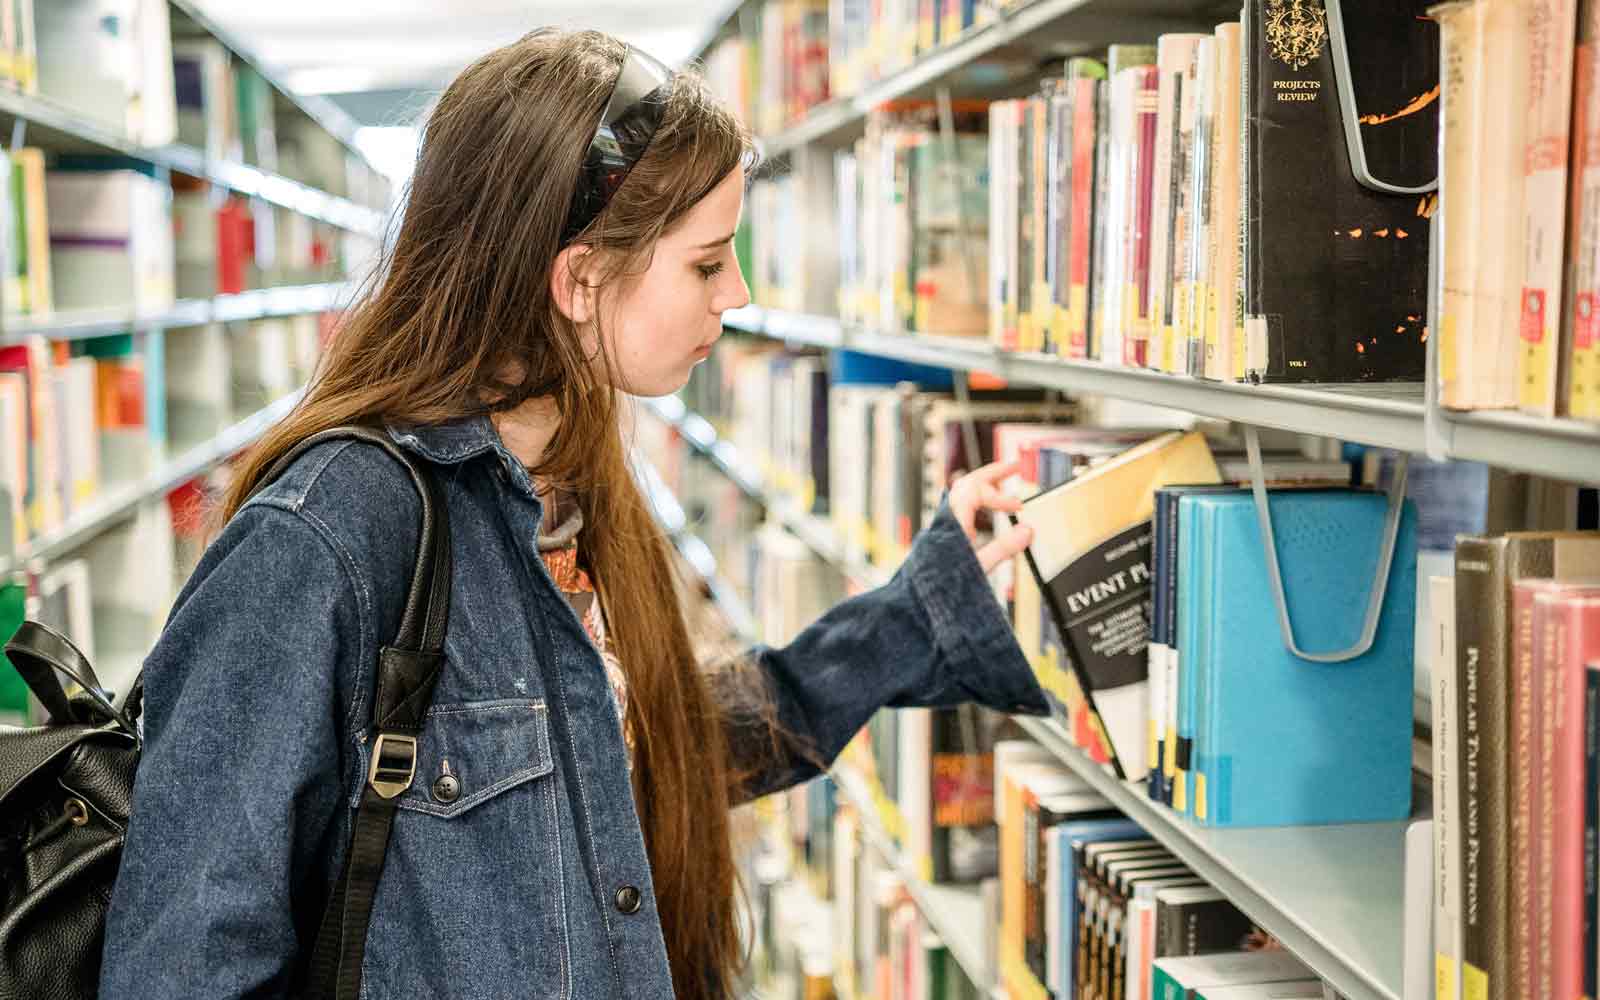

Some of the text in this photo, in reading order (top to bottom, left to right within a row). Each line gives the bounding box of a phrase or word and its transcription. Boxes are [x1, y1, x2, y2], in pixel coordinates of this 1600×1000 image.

[1273, 80, 1320, 90] PROJECTS
[1277, 92, 1317, 101] REVIEW
[1066, 570, 1127, 613] EVENT
[1467, 647, 1480, 925] POPULAR TALES AND FICTIONS
